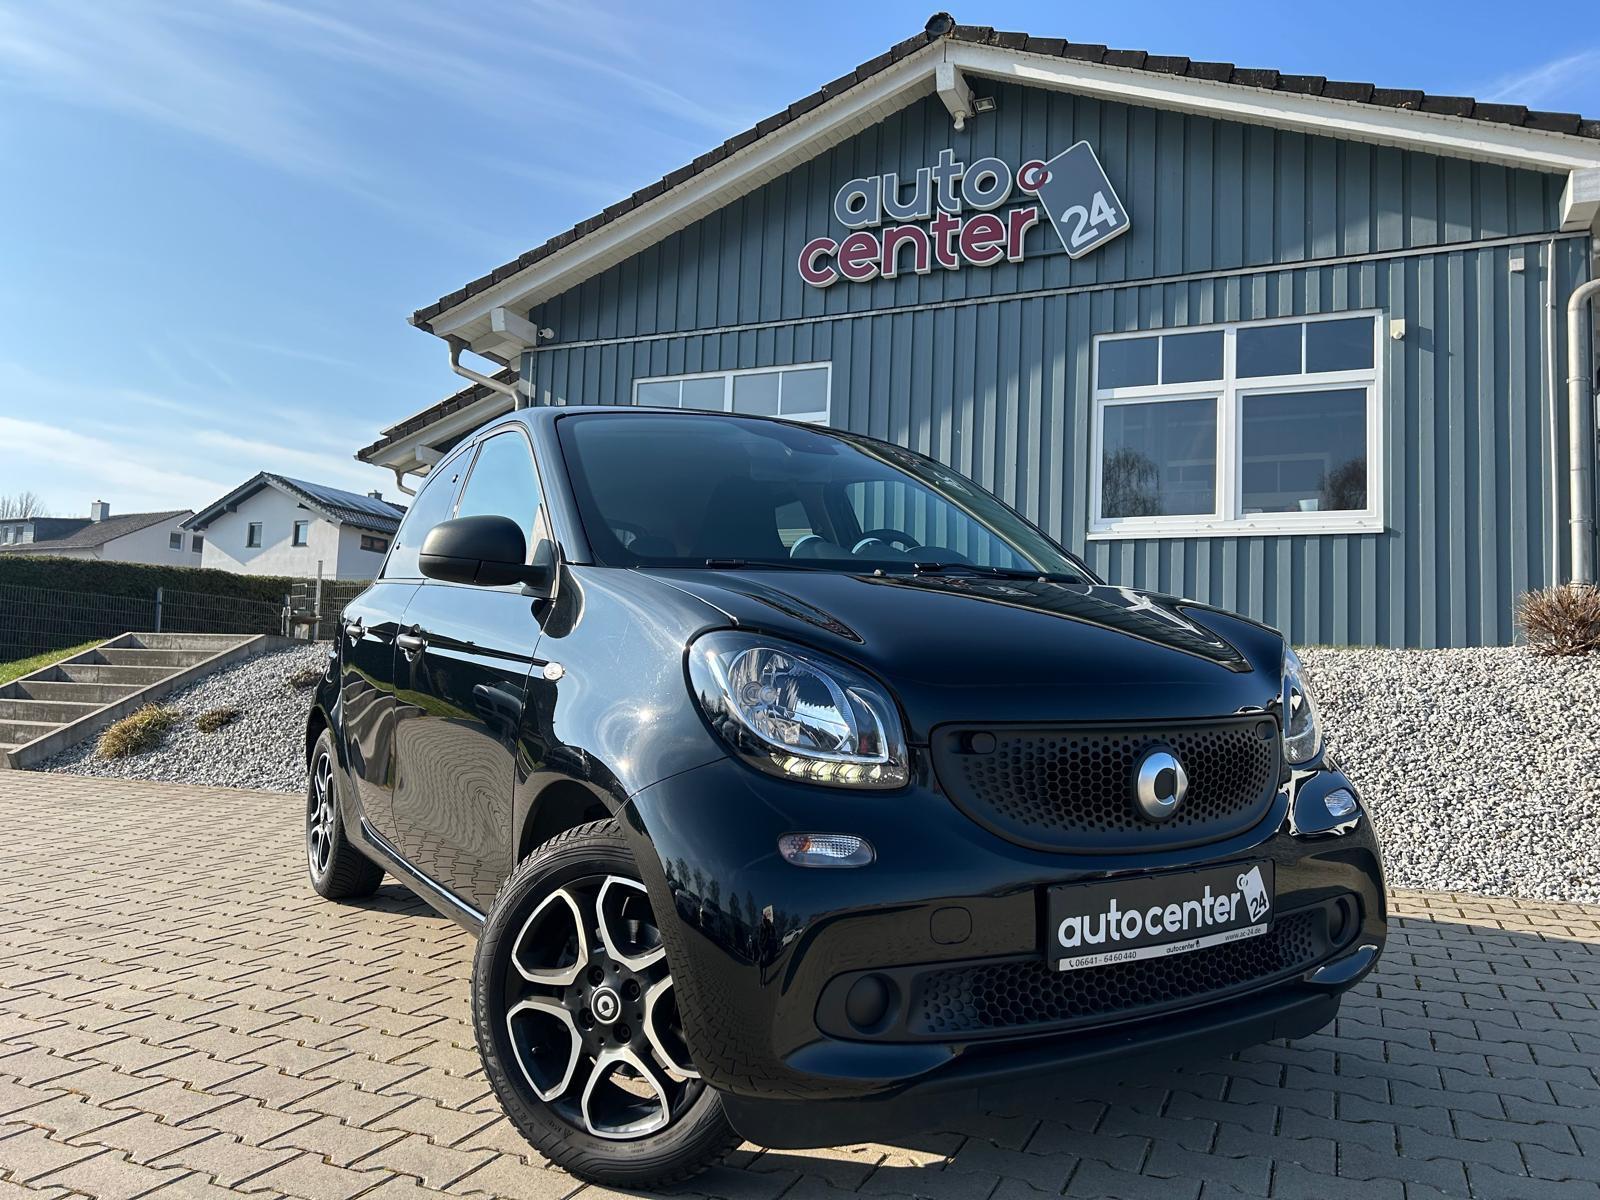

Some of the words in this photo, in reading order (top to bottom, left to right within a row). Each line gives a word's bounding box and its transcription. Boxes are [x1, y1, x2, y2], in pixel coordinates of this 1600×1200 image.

[834, 148, 1013, 229] auto
[1060, 190, 1117, 248] 24
[798, 206, 1038, 288] center
[1250, 890, 1268, 919] 24
